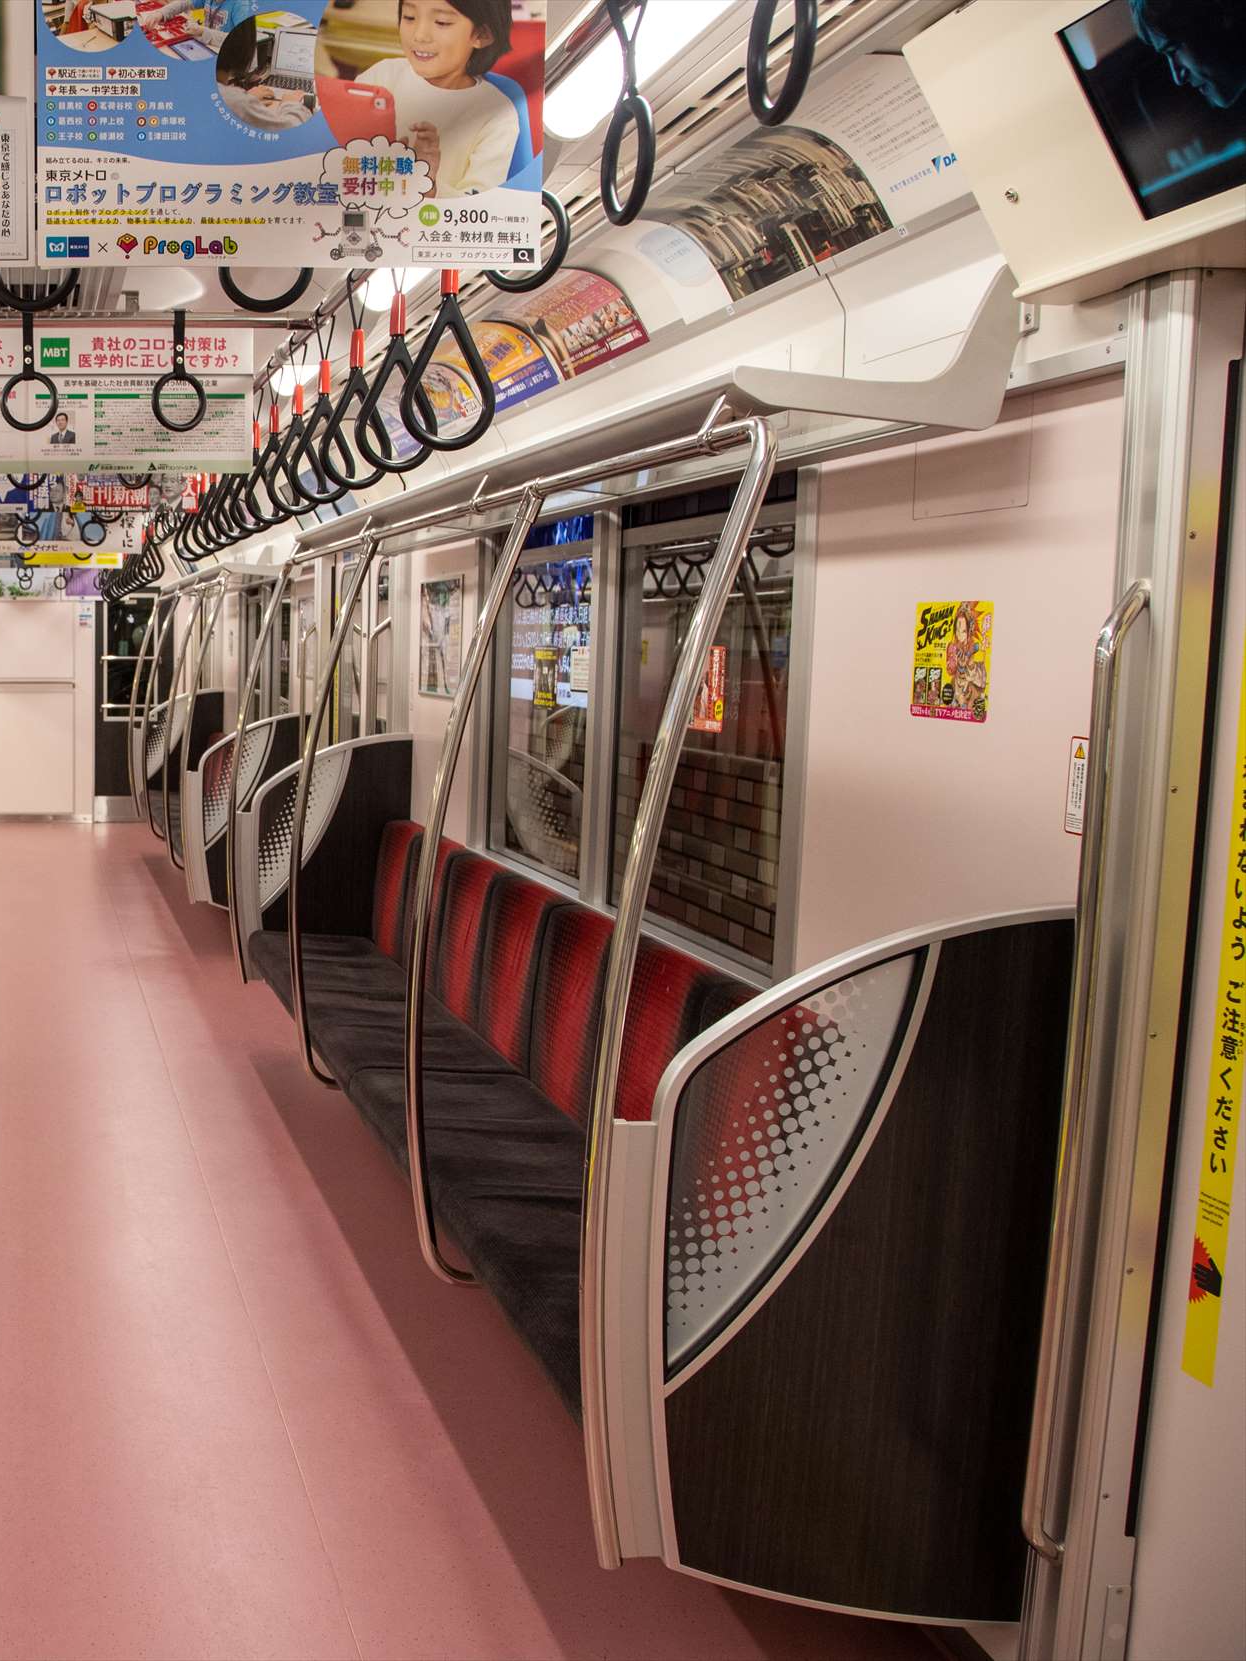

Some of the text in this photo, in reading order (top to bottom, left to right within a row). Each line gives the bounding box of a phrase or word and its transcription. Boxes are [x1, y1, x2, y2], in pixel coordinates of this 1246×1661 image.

[57, 68, 77, 79] 駅近
[118, 68, 166, 79] 初心者歓迎
[342, 156, 414, 176] 無料体験
[45, 169, 107, 182] 東京メトロ
[45, 182, 339, 205] ロボットプログラミング教室
[443, 209, 489, 226] 9,800
[143, 235, 239, 260] ProgLab
[42, 347, 68, 359] MBT
[78, 353, 239, 369] 医学的に正しですか？
[81, 483, 147, 505] 週刊新潮
[1210, 979, 1245, 1174] ご注意ください
